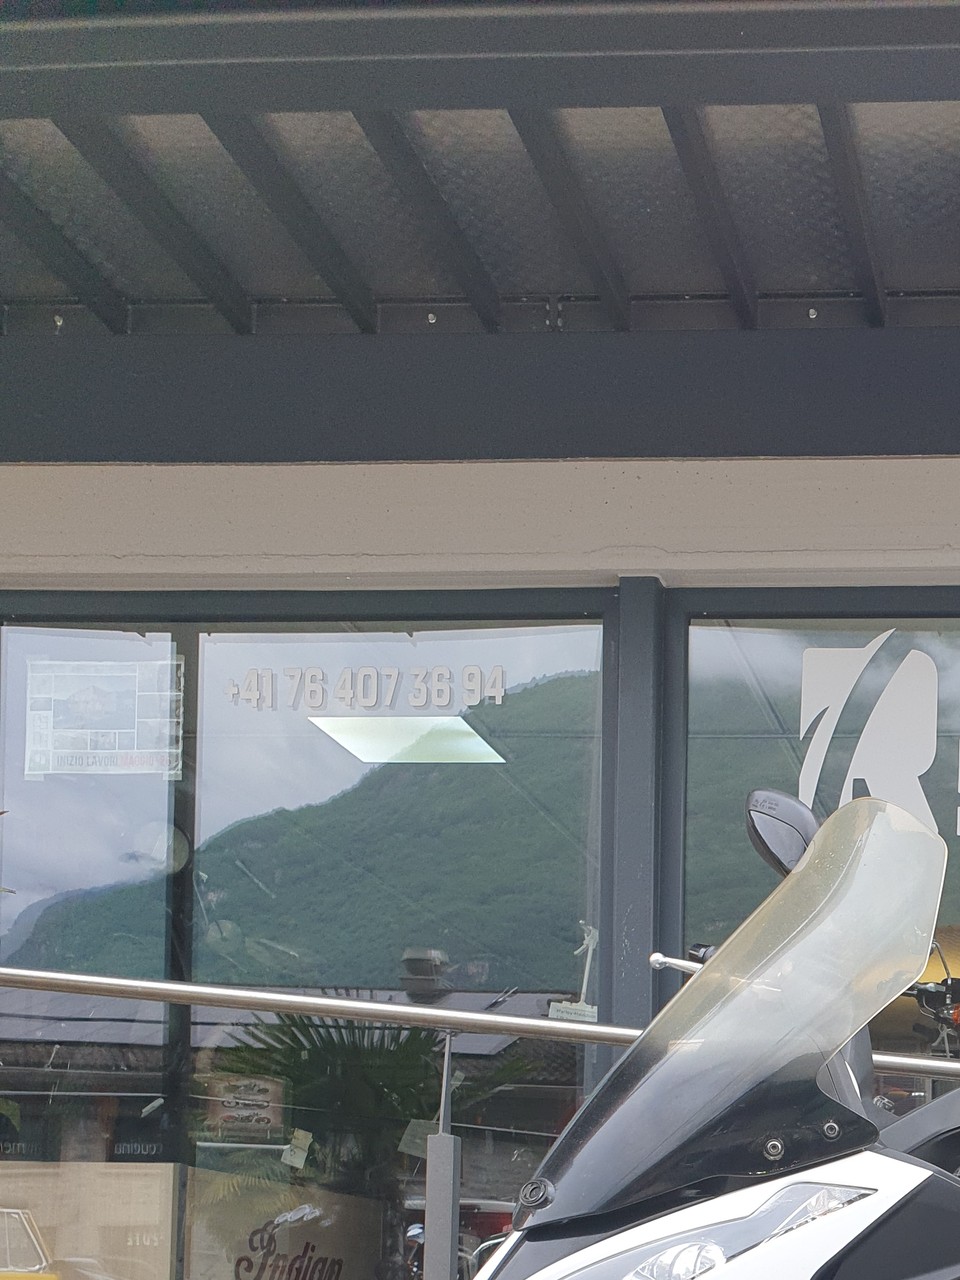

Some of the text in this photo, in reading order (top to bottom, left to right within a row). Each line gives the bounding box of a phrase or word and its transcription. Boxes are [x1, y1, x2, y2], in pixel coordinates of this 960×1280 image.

[224, 664, 505, 709] +41 76 407 36 94
